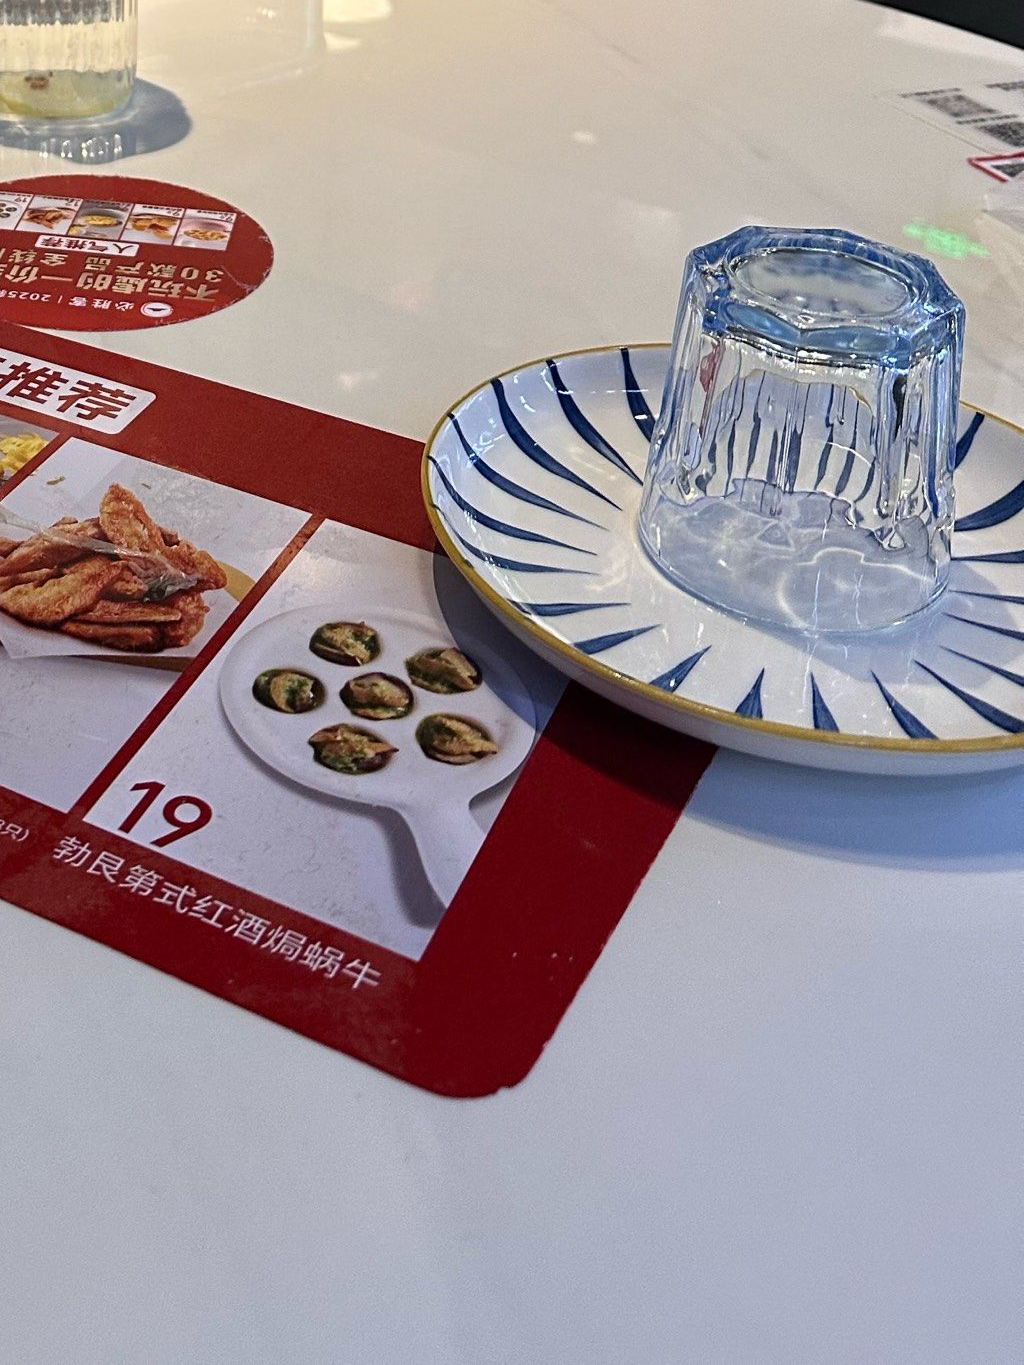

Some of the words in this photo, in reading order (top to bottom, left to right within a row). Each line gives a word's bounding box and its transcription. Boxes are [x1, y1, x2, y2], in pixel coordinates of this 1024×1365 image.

[40, 236, 137, 255] 人气推荐
[85, 256, 224, 283] 30款产品
[70, 294, 135, 315] 必胜客
[117, 779, 213, 847] 19
[53, 835, 382, 990] 勃艮第式红酒焗蜗牛
